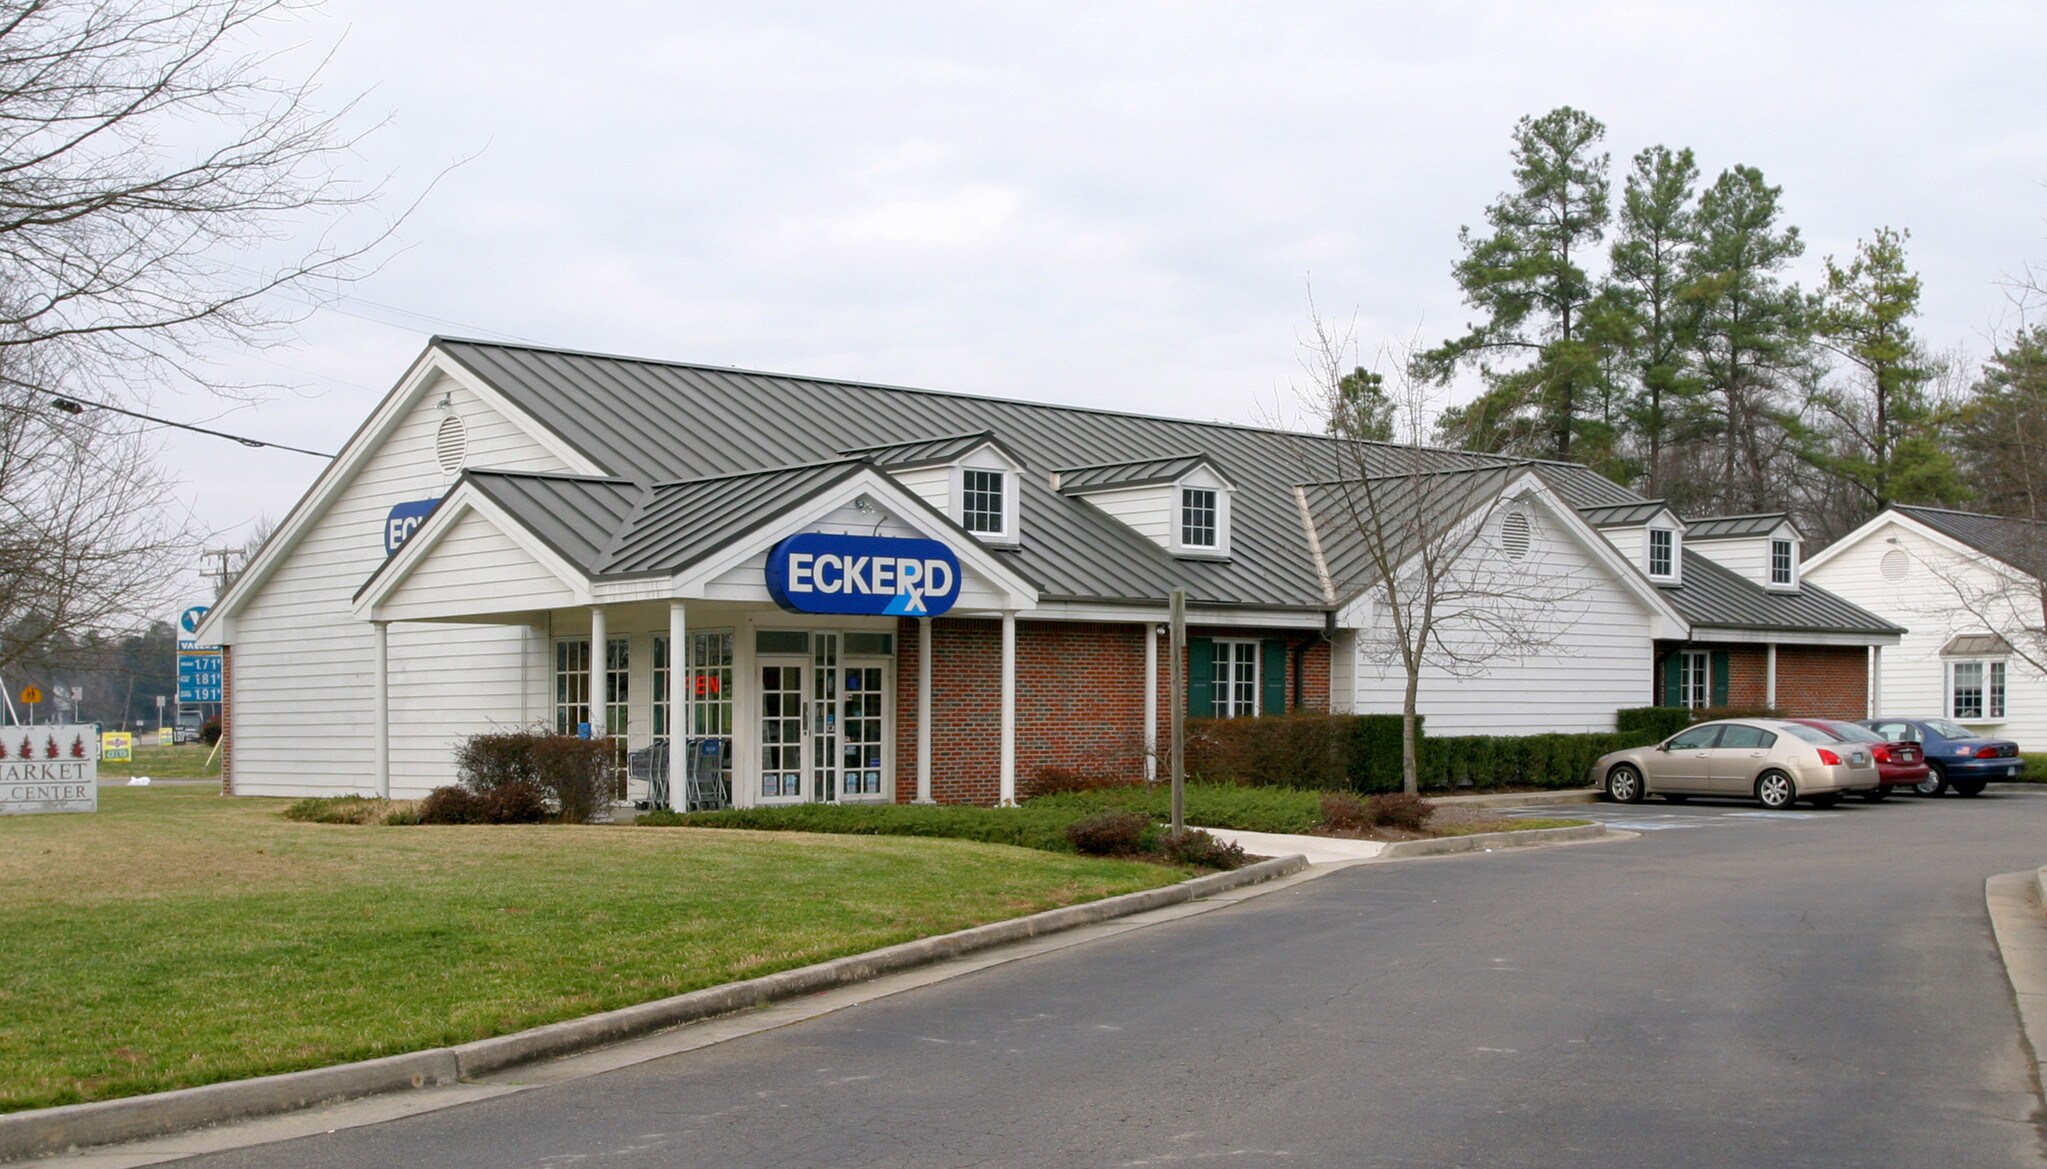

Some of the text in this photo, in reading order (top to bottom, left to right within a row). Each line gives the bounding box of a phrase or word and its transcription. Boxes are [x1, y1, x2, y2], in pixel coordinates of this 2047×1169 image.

[390, 516, 422, 550] EC
[788, 552, 954, 597] ECKERD
[0, 763, 87, 780] ARKET
[11, 785, 86, 800] CENTER
